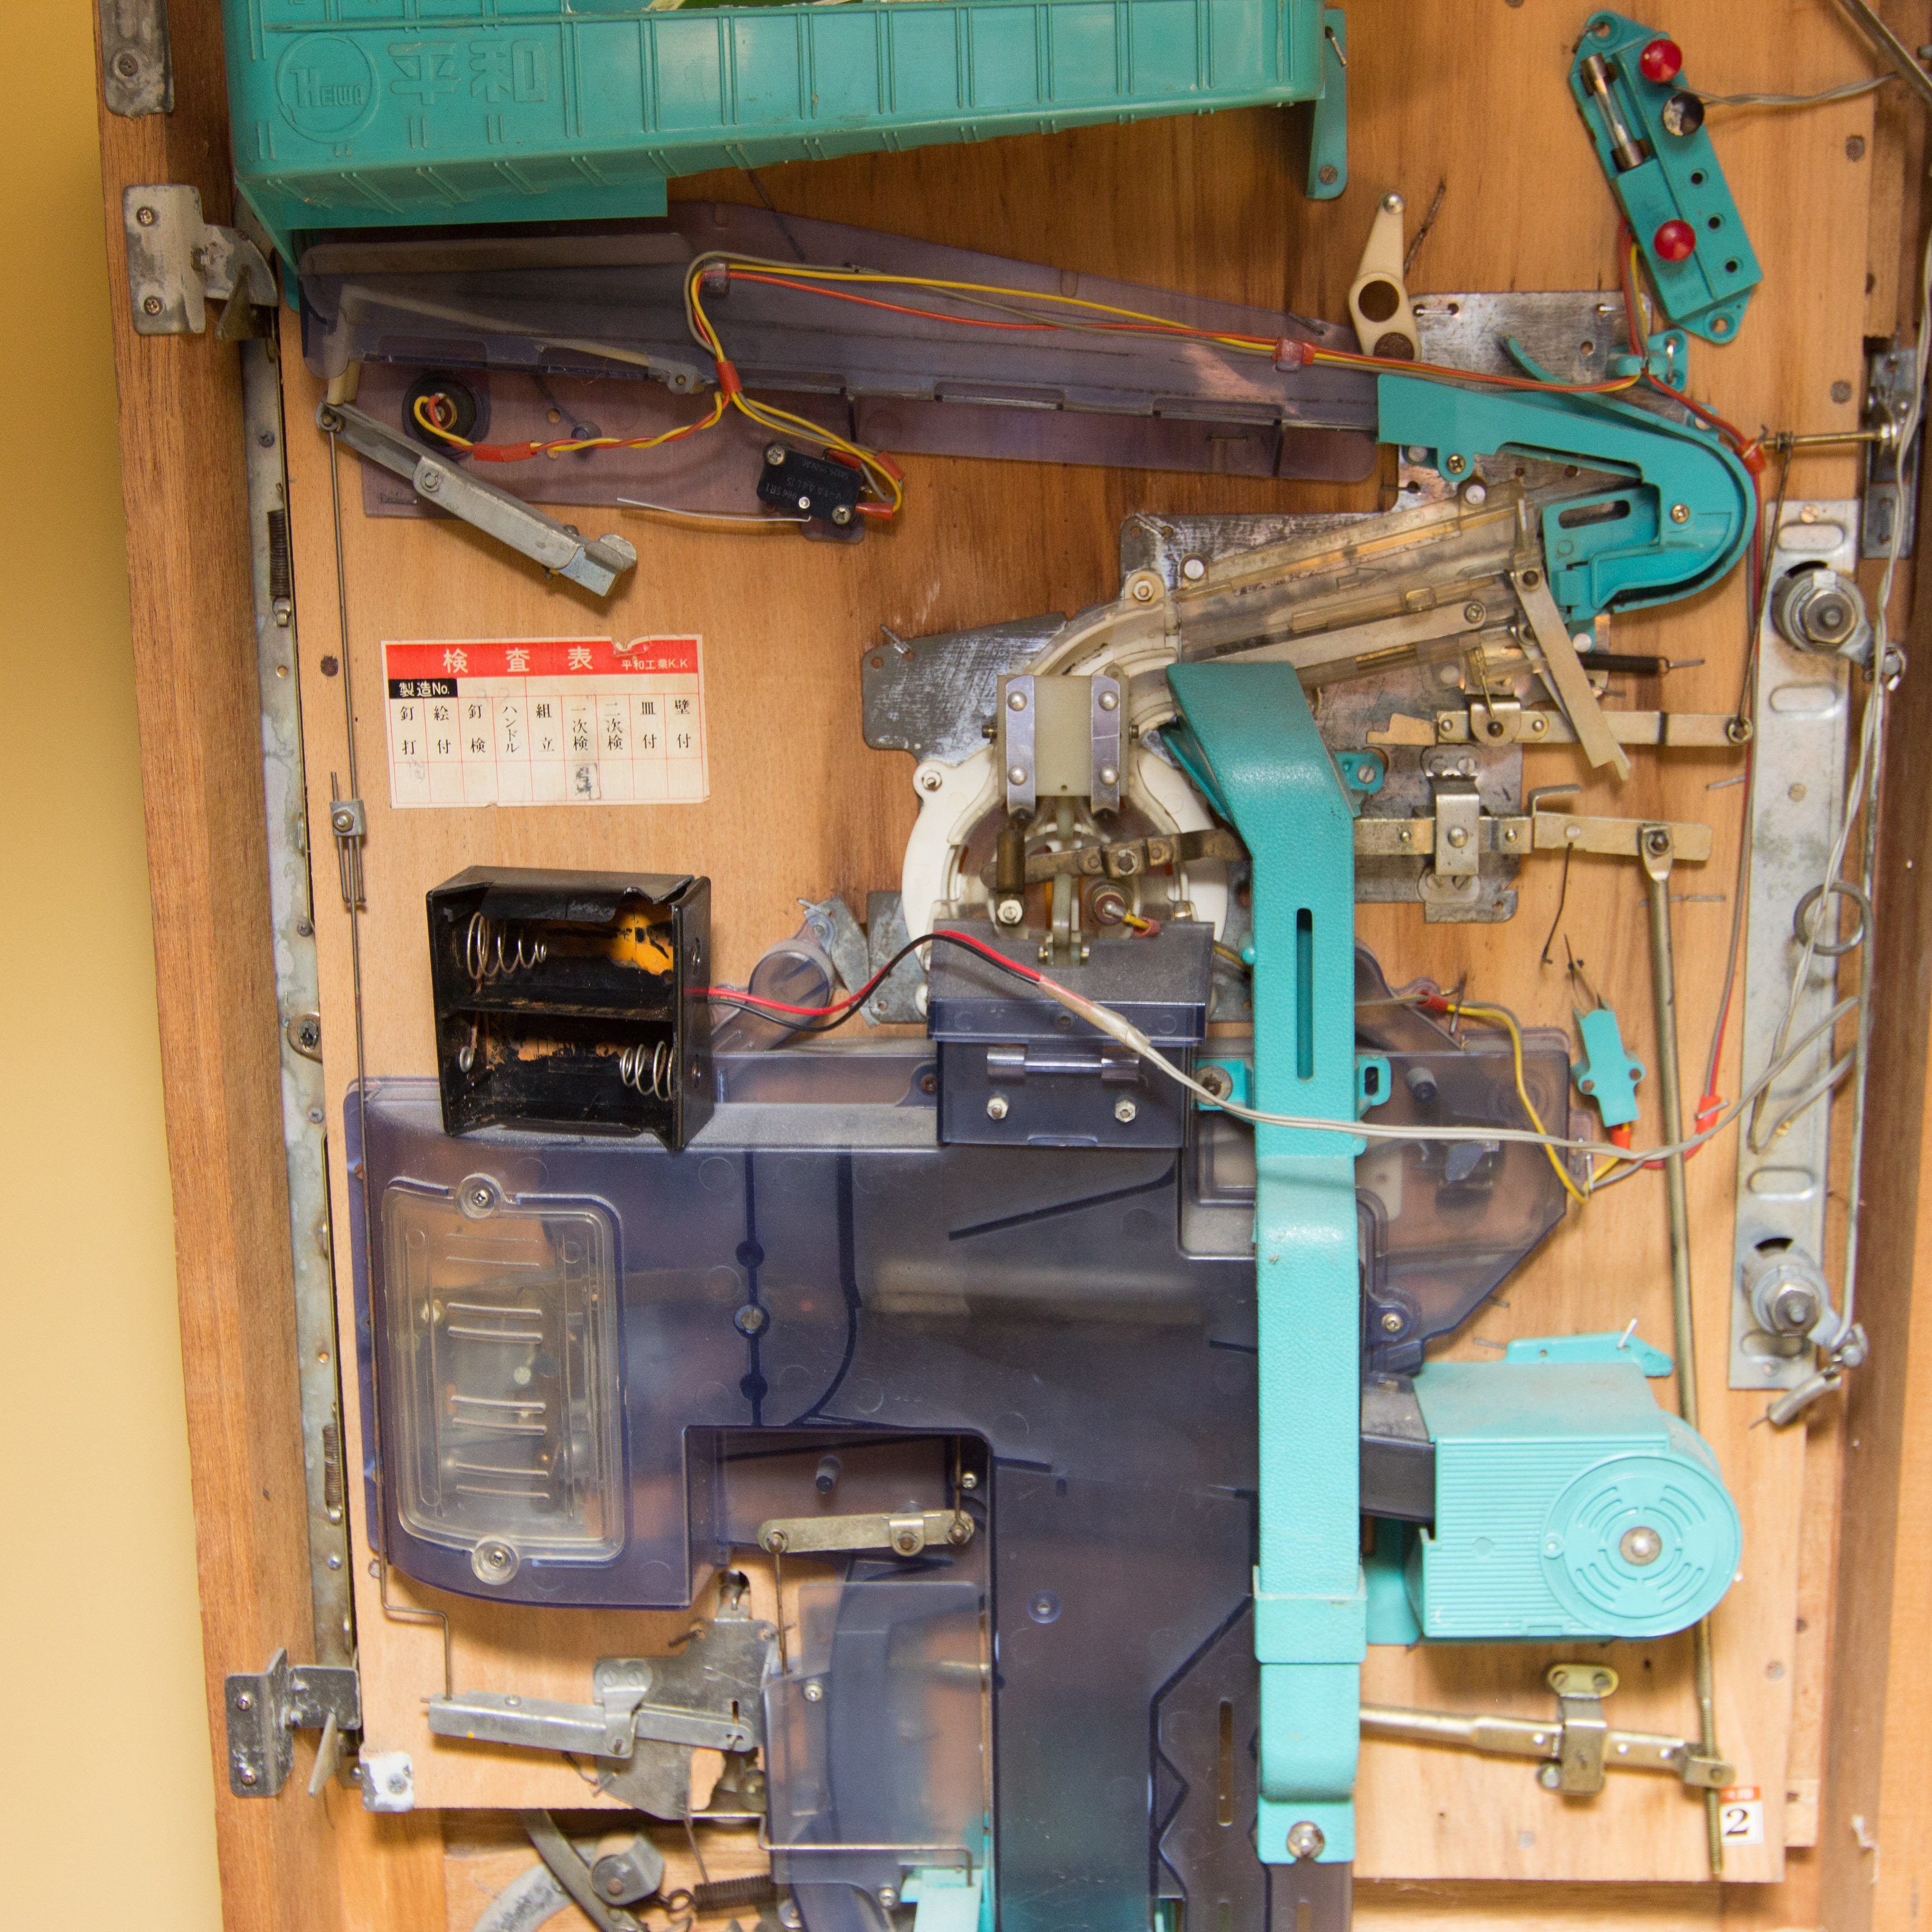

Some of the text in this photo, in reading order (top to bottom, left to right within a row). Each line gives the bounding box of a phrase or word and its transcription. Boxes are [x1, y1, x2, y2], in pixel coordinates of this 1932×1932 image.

[289, 65, 365, 107] HEIWA
[389, 39, 546, 105] 平和
[503, 706, 519, 753] ハンドル
[536, 703, 555, 752] 組立
[571, 707, 589, 751] 一次検
[605, 703, 623, 751] 二次検
[1726, 1808, 1749, 1836] 2
